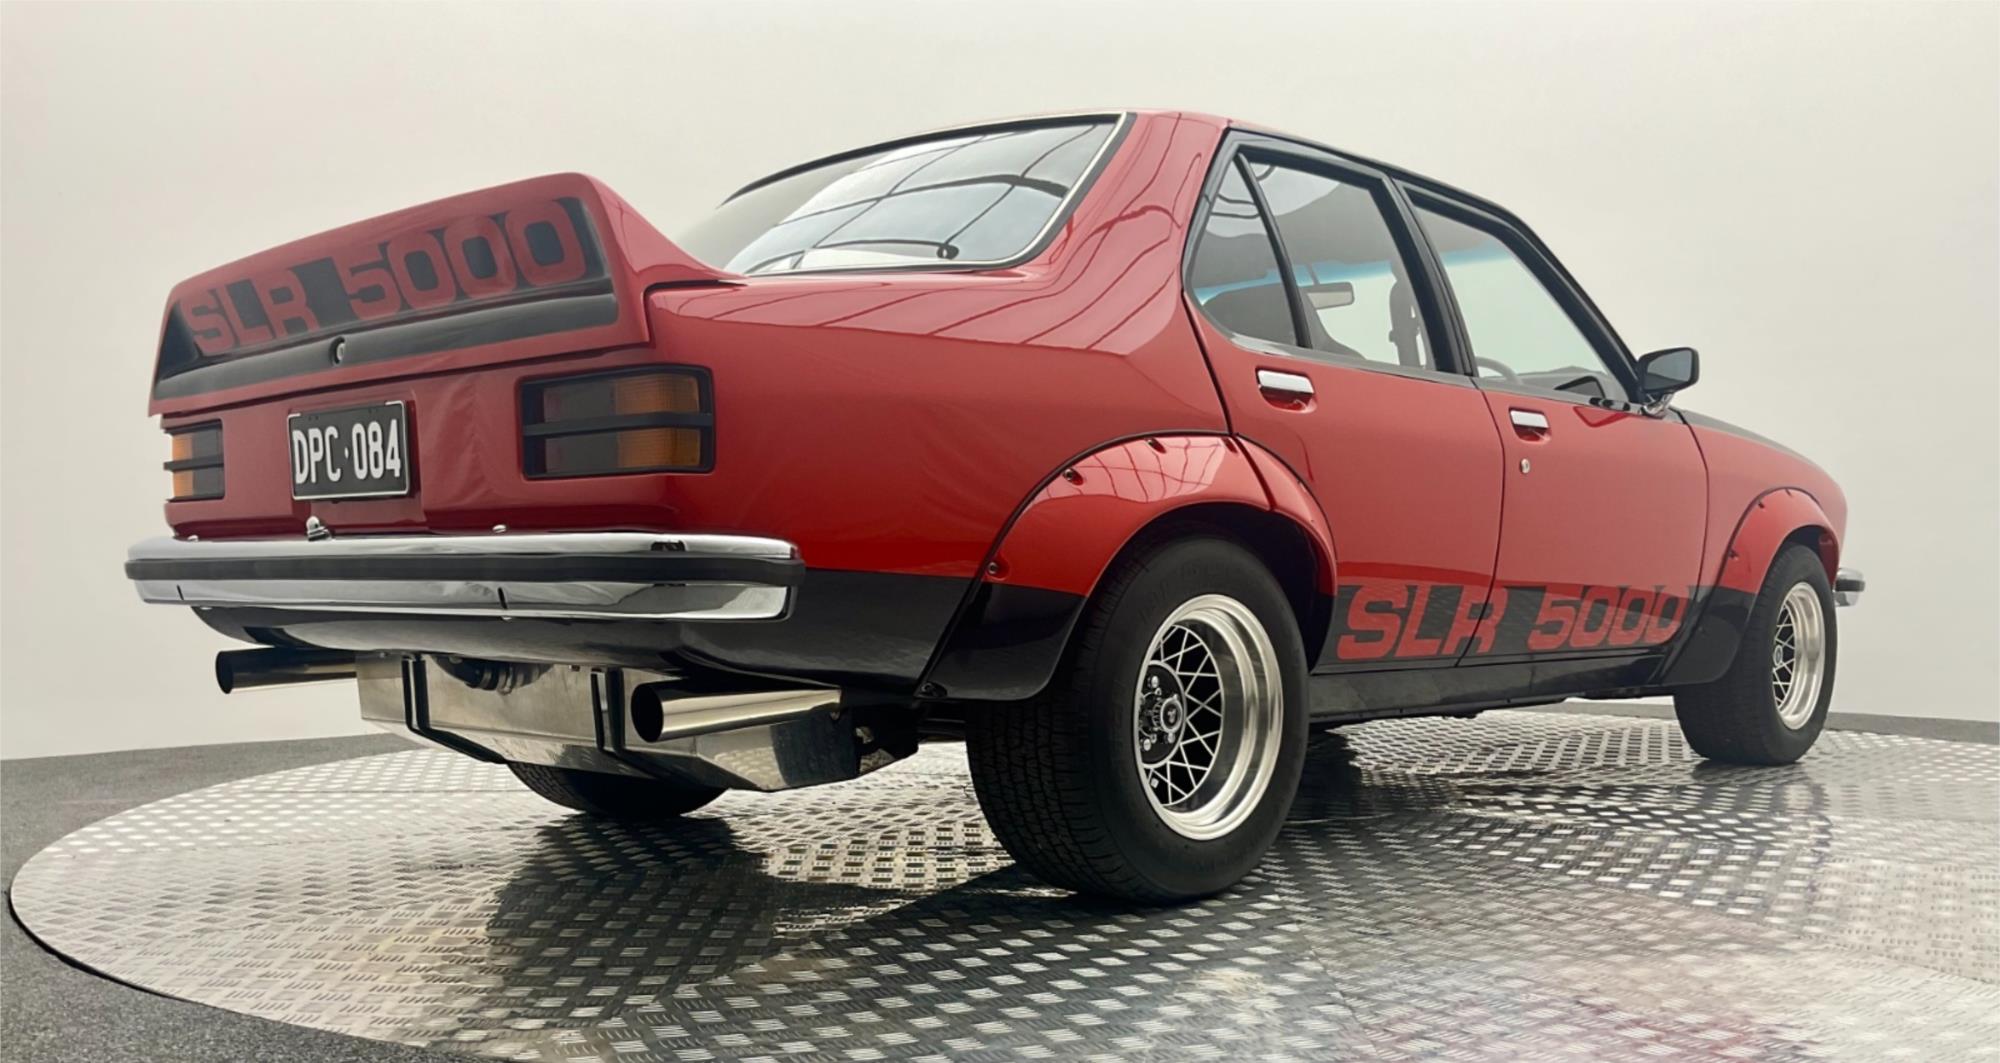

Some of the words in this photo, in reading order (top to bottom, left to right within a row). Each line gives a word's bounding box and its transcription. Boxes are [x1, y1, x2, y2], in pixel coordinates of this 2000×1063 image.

[180, 267, 319, 356] SLR
[334, 201, 587, 320] 5000
[1337, 585, 1507, 660] SLR
[1527, 585, 1690, 650] 5000
